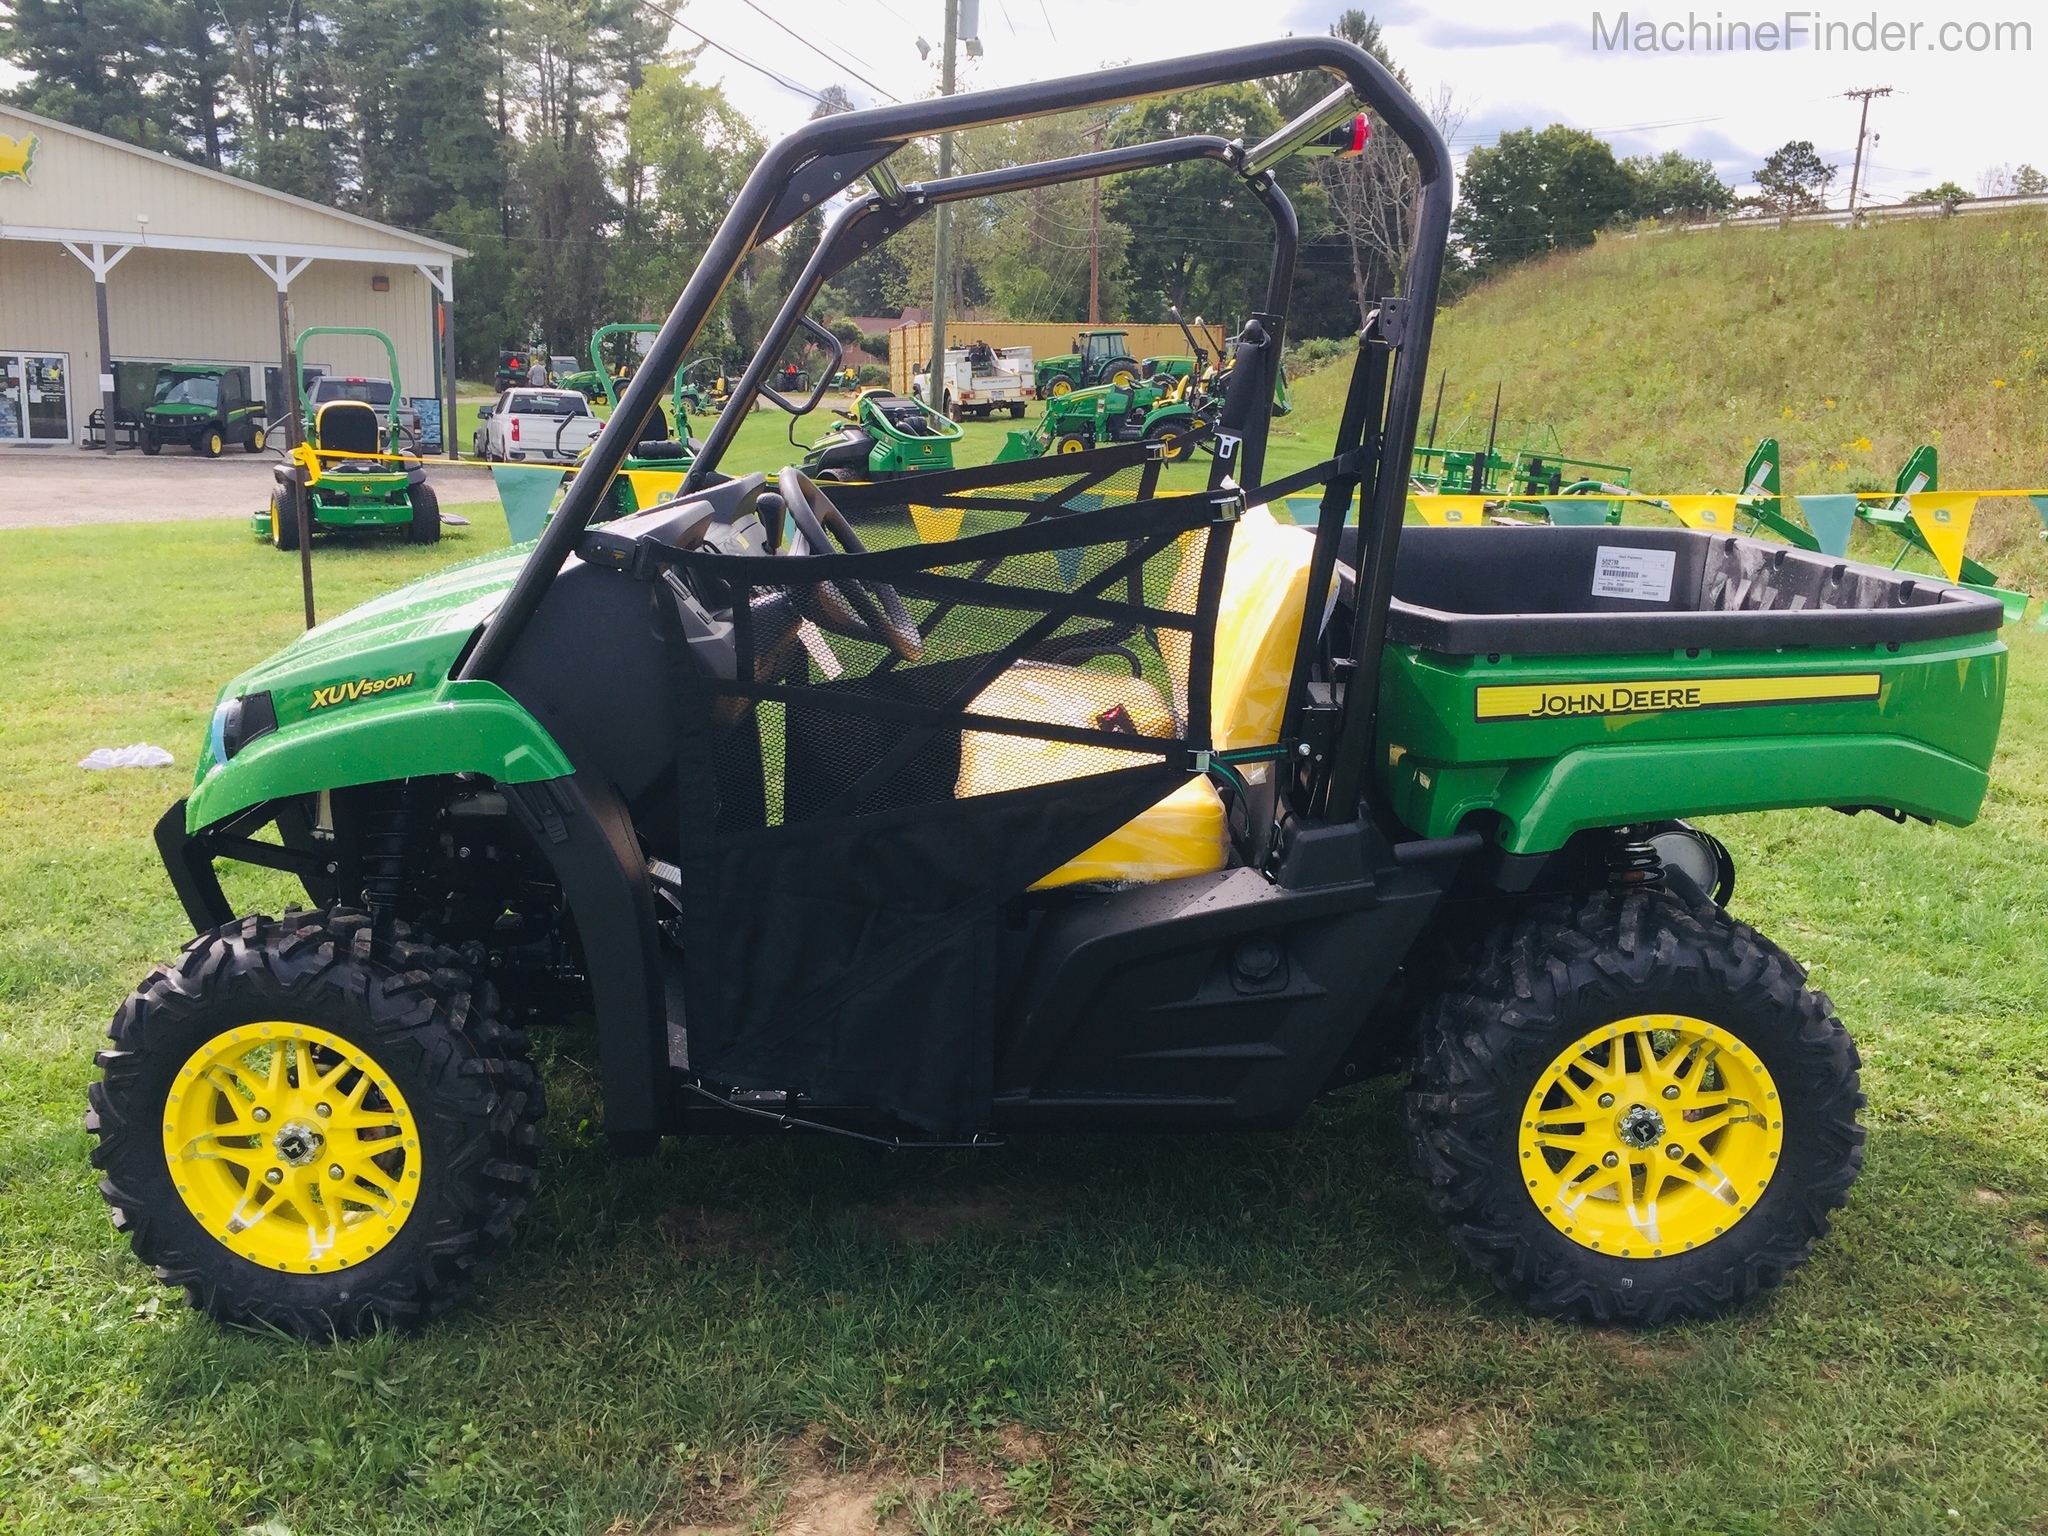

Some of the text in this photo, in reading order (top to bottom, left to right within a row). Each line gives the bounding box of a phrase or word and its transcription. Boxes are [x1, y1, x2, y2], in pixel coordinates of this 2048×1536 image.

[308, 671, 415, 711] XUV590M
[1532, 688, 1701, 714] JOHN DEERE
